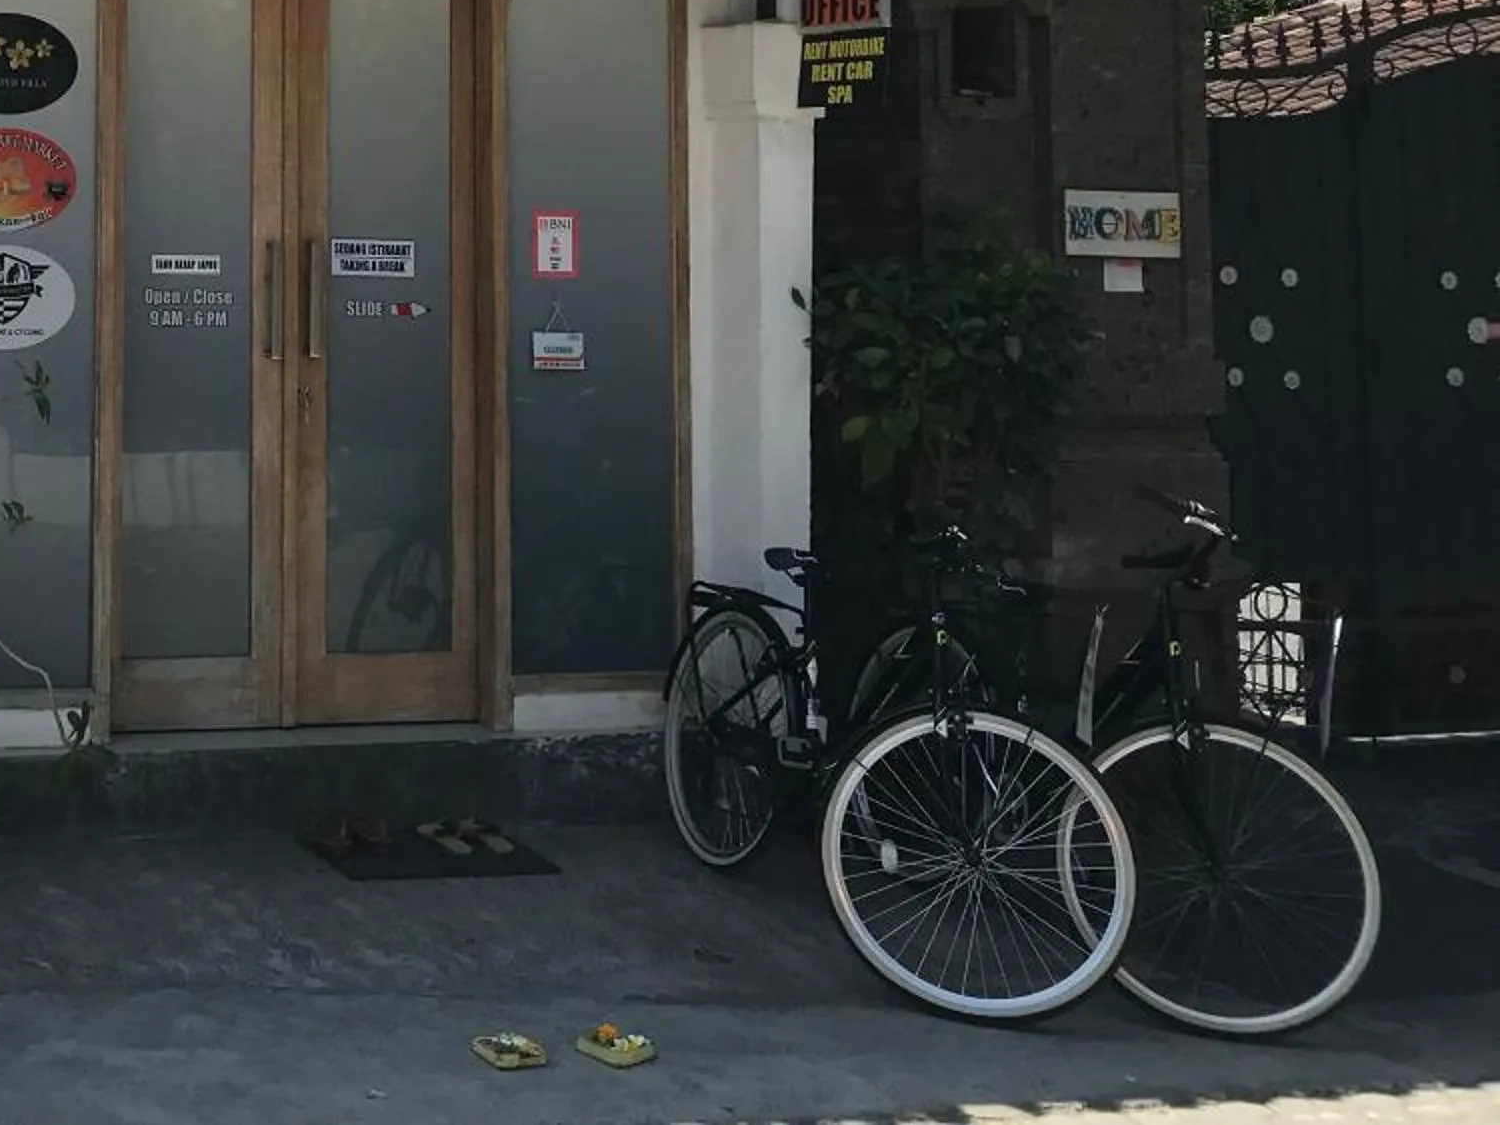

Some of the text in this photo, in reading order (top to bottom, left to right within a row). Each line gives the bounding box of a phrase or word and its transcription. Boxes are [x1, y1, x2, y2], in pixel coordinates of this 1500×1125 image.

[803, 42, 828, 60] RENT
[811, 61, 873, 83] RENT CAR
[827, 85, 853, 104] SPA
[378, 260, 405, 272] BREAK
[145, 287, 181, 305] Open
[193, 288, 233, 304] Close
[347, 301, 383, 316] SLIDE
[149, 310, 159, 326] 9
[161, 310, 183, 326] AM
[194, 311, 203, 326] 6
[207, 311, 227, 327] PM
